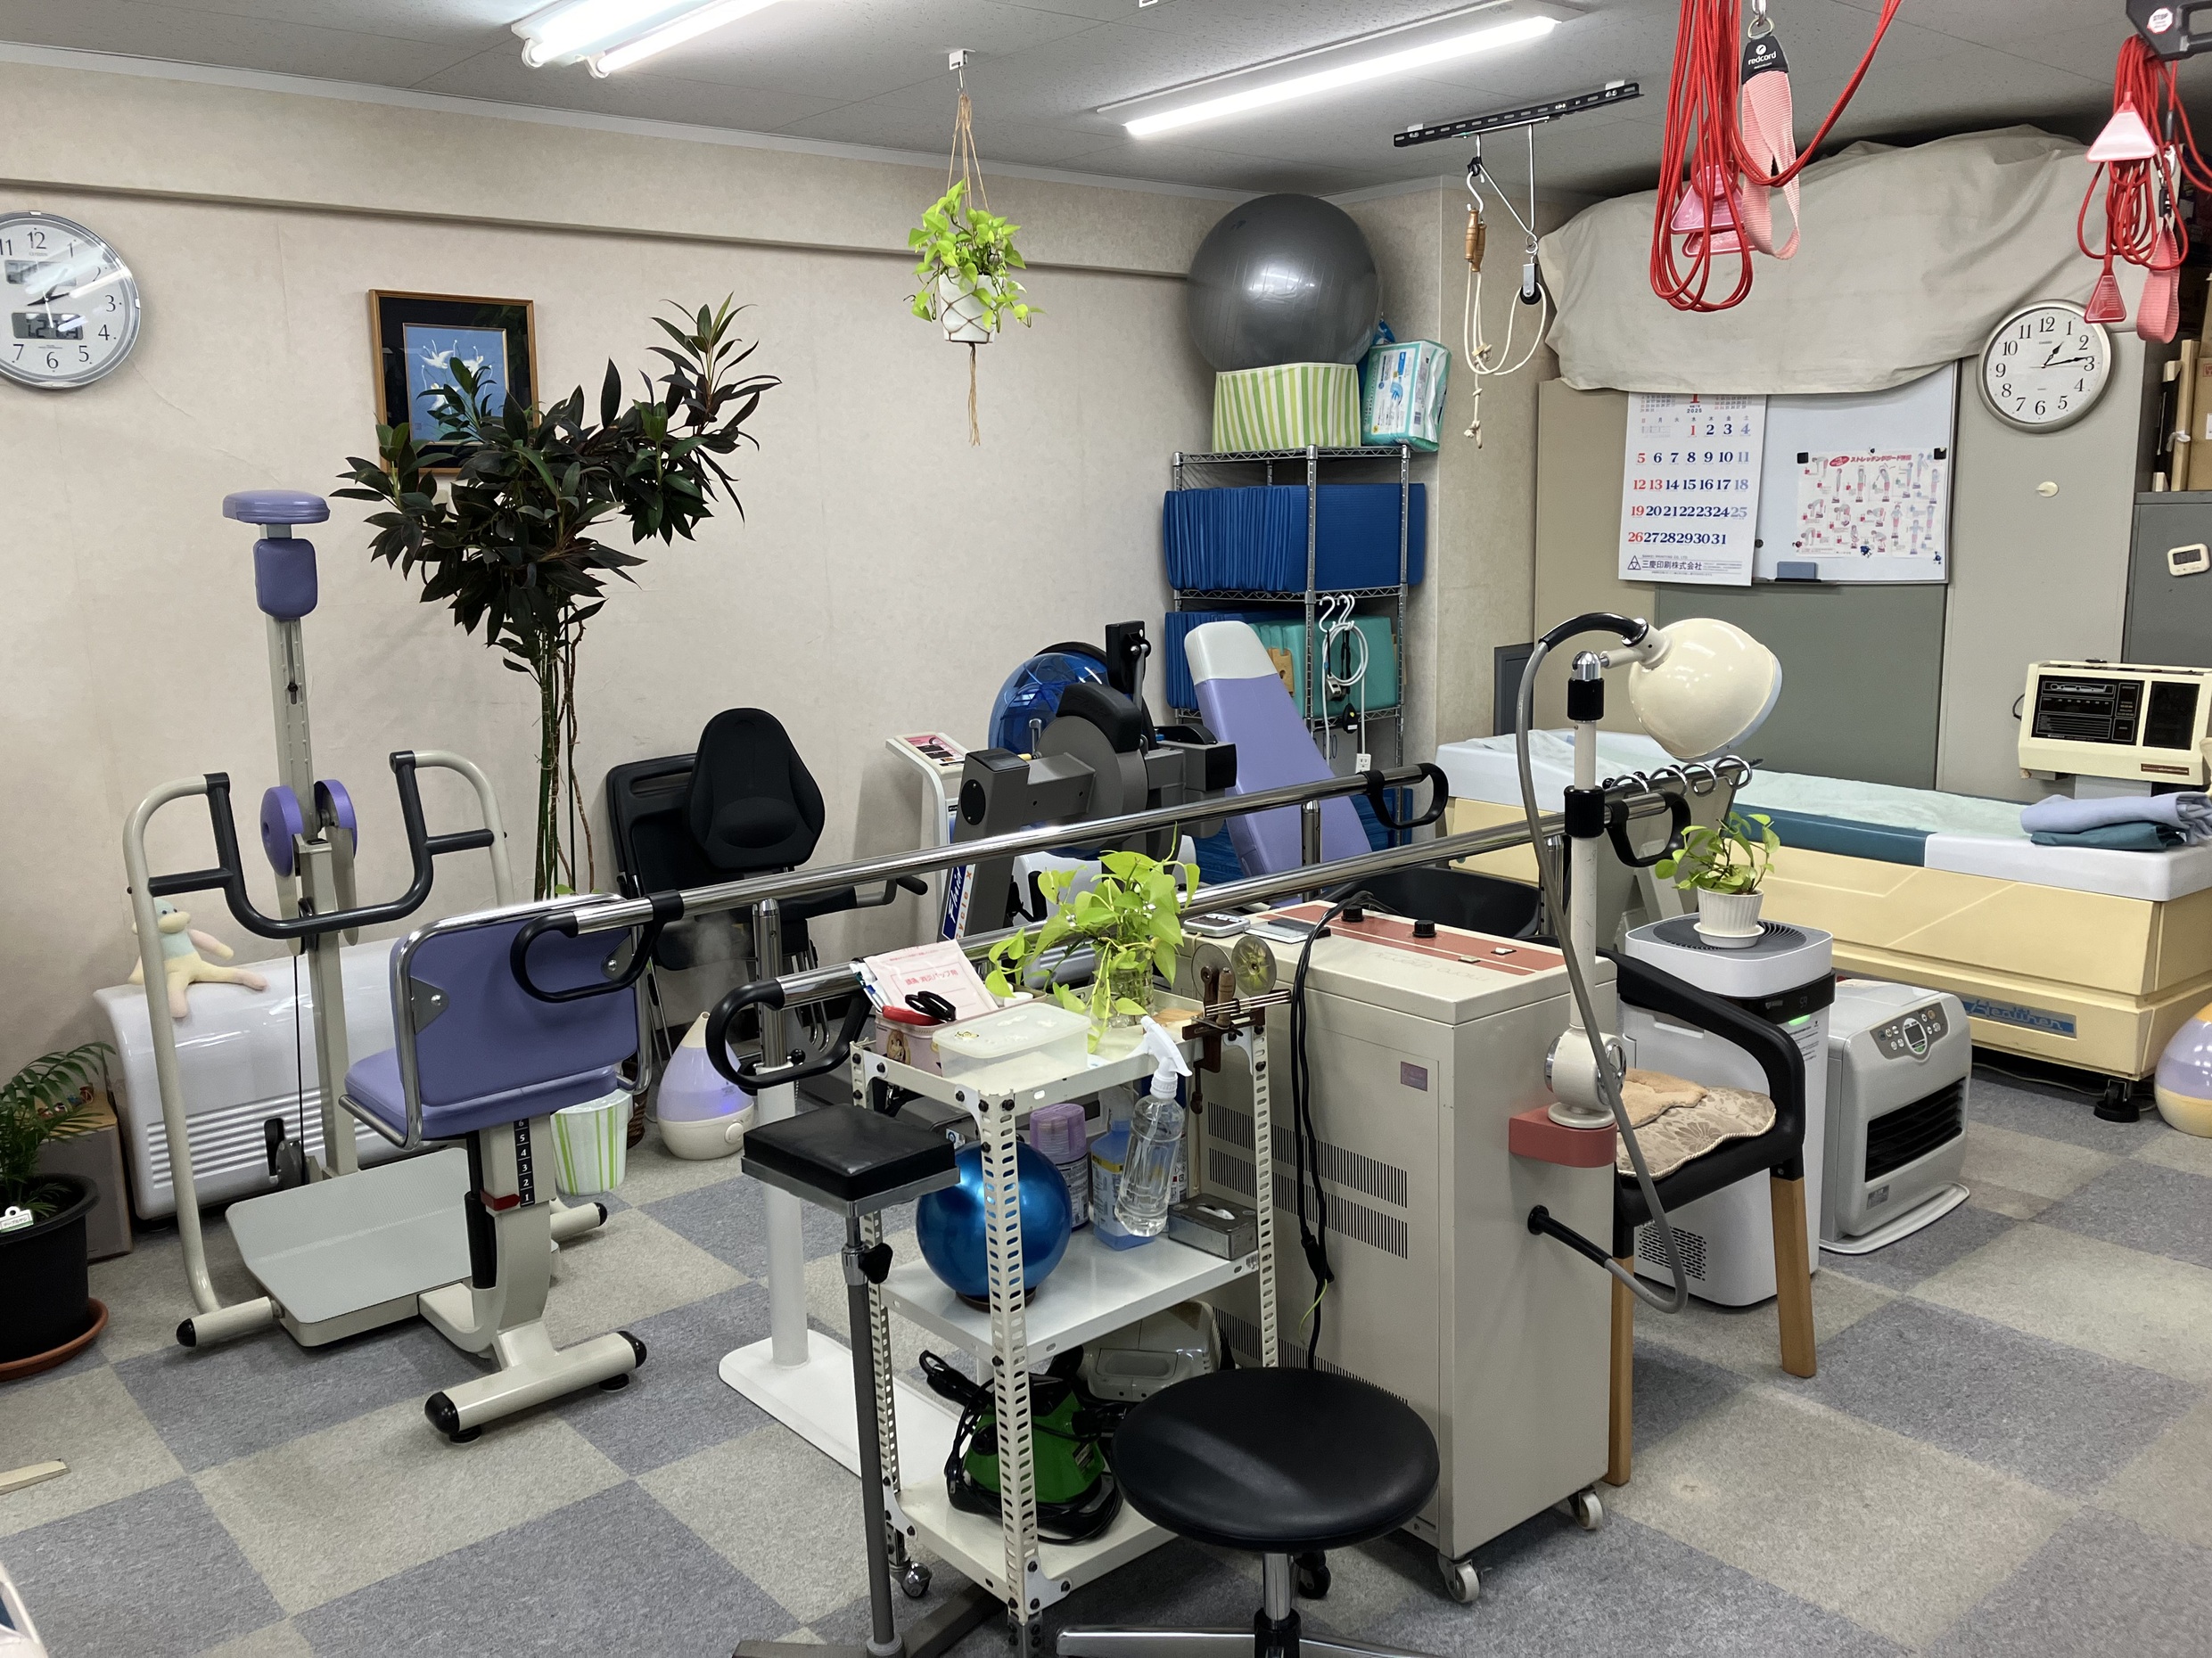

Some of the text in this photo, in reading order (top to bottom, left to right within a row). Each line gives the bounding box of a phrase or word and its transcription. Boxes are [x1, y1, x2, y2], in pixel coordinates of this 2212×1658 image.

[1747, 50, 1776, 65] redcord
[27, 231, 47, 250] 12
[67, 242, 74, 259] 1
[105, 295, 116, 312] 3
[2039, 316, 2055, 332] 12
[2067, 321, 2072, 335] 1
[98, 324, 111, 341] 4
[2019, 324, 2031, 339] 11
[2002, 341, 2018, 357] 10
[2079, 335, 2089, 351] 2
[12, 344, 24, 360] 7
[78, 346, 89, 362] 5
[46, 351, 59, 369] 6
[2084, 357, 2095, 371] 3
[1995, 364, 2006, 378] 9
[2001, 383, 2011, 398] 8
[2074, 378, 2085, 392] 4
[2016, 398, 2026, 412] 7
[2035, 401, 2045, 415] 6
[2058, 396, 2068, 410] 5
[1690, 423, 1750, 436] 1 2 3 4
[1637, 452, 1749, 464] 5 6 7 8 9 10 11
[1633, 479, 1748, 490] 12 13 14 15 16 17 18
[1632, 505, 1747, 518] 19 20 21 22 23 24 25
[1628, 532, 1726, 545] 26 27 28 29 30 31
[520, 1134, 525, 1142] 5
[521, 1149, 526, 1157] 4
[522, 1164, 528, 1172] 3
[525, 1194, 530, 1202] 1
